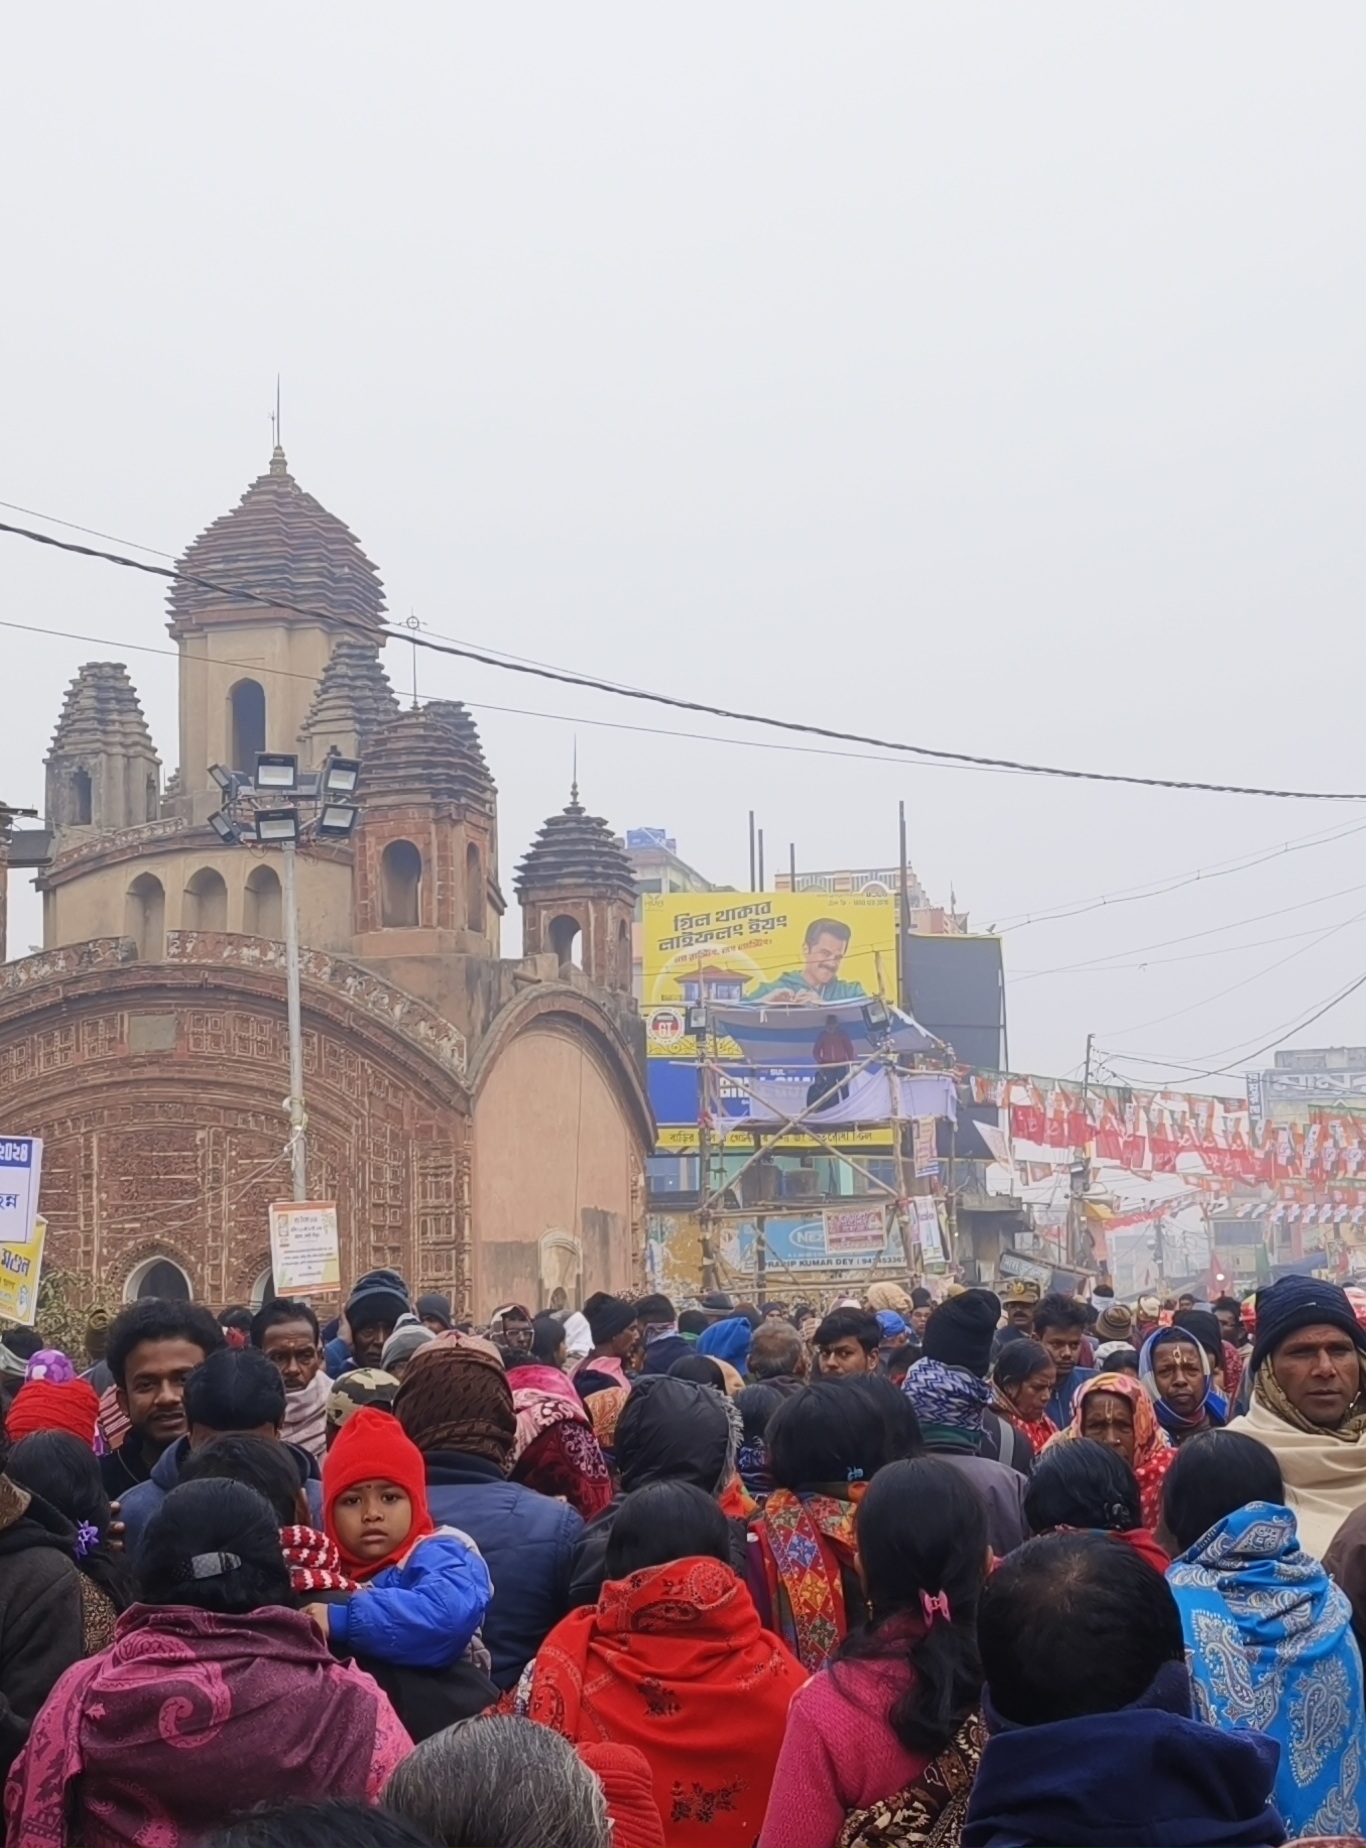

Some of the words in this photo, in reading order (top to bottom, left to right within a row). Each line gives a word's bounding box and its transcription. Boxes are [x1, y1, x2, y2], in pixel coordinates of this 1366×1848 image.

[673, 912, 712, 932] গ্রিল
[715, 900, 772, 922] থাকবে
[657, 923, 744, 952] লাইফলং
[748, 915, 788, 935] ইয়ং
[799, 1258, 833, 1268] KUMAR
[836, 1257, 855, 1266] DEY
